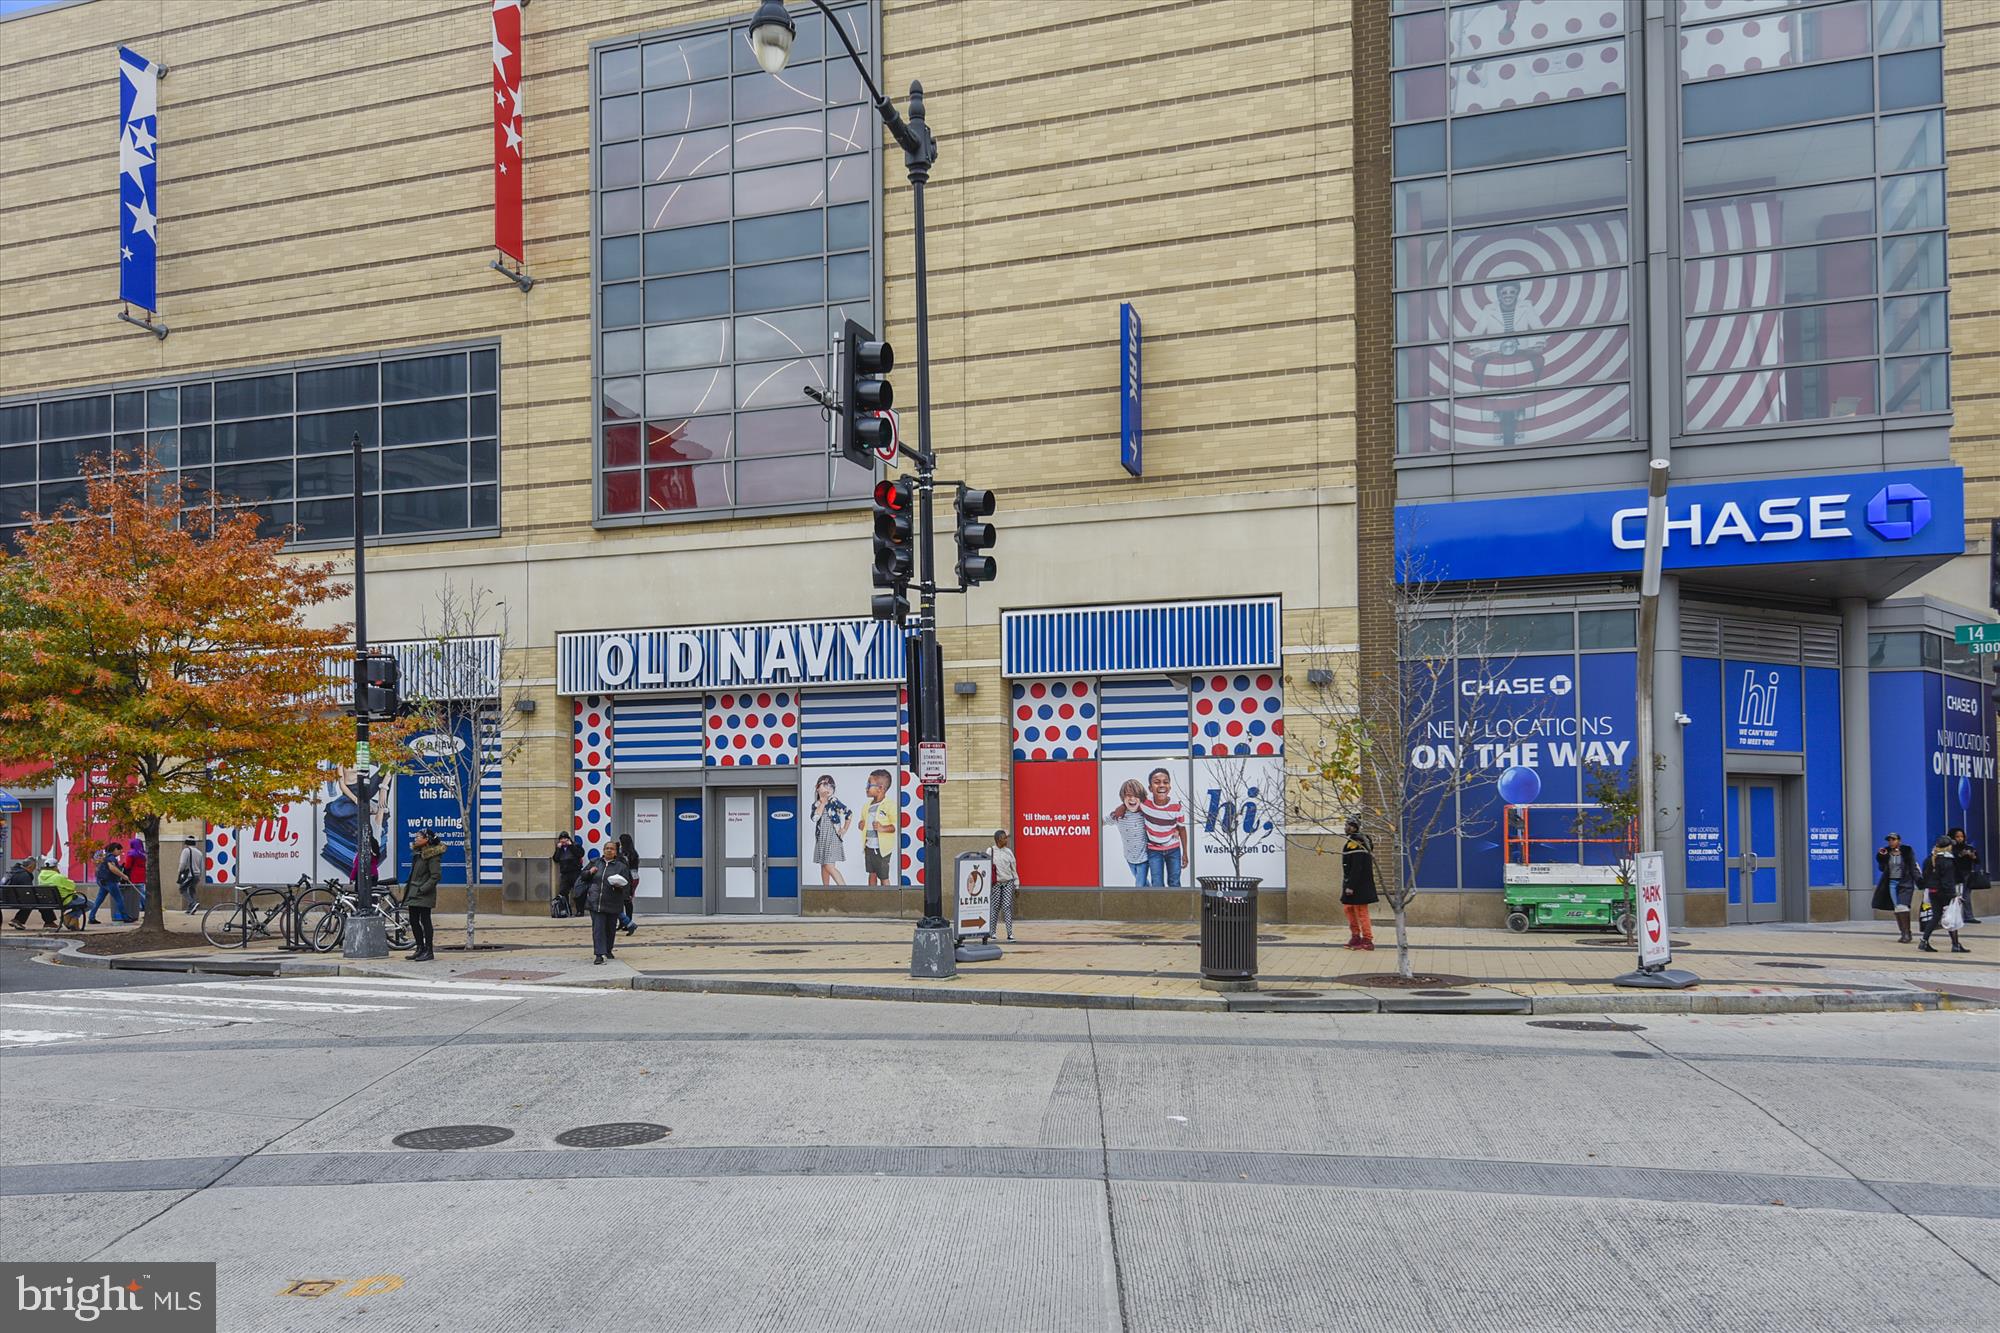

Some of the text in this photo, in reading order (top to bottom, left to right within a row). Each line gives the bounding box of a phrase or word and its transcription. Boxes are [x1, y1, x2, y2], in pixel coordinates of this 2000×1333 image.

[1129, 308, 1138, 402] PARK
[1611, 494, 1853, 550] CHASE
[1968, 626, 1984, 641] 14
[598, 622, 880, 686] OLD NAVY
[1972, 642, 2000, 654] 3100
[1461, 677, 1546, 696] CHASE
[1739, 669, 1780, 727] hi
[1947, 695, 1971, 714] CHASE
[1427, 716, 1613, 739] NEW LOCATIONS
[1739, 728, 1748, 736] WE
[1764, 730, 1778, 738] WAIT
[1937, 729, 1991, 752] NEW LOCATIONS
[1411, 741, 1631, 769] ON THE WAY
[1933, 751, 1995, 780] ON THE WAY
[419, 788, 438, 799] this
[1034, 812, 1053, 822] then,
[1067, 814, 1080, 822] you
[1081, 812, 1090, 821] at
[1204, 787, 1274, 839] hi,
[408, 816, 463, 829] we're hiring
[1023, 825, 1092, 836] OLDNAVY.COM
[252, 851, 288, 859] Washington
[1262, 844, 1275, 854] DC
[960, 896, 989, 905] LETENA
[1643, 884, 1661, 902] PARK
